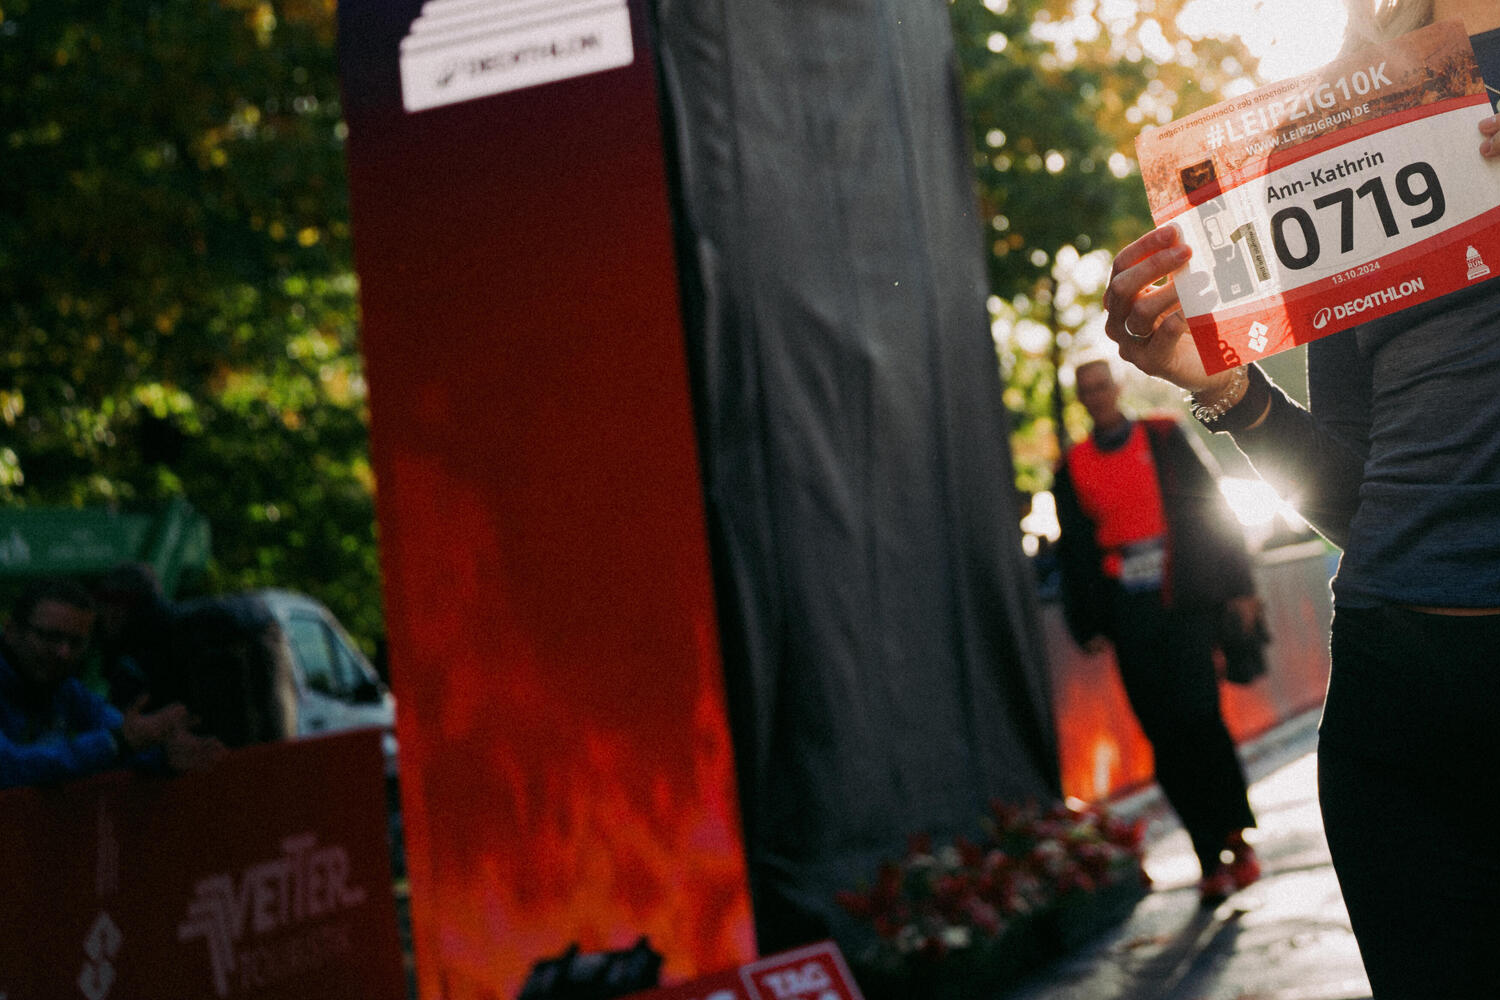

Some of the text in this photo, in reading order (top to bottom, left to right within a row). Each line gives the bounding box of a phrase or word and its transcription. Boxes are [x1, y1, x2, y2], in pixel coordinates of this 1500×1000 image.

[1206, 61, 1393, 150] #LEIPZIG10K
[1245, 102, 1371, 156] WWW.LEIPZIGRUN.DE
[1266, 149, 1385, 204] Ann-Kathrin
[1229, 160, 1447, 283] 10719
[1331, 261, 1381, 285] 13.10.2024
[1332, 276, 1425, 321] DECATHLON
